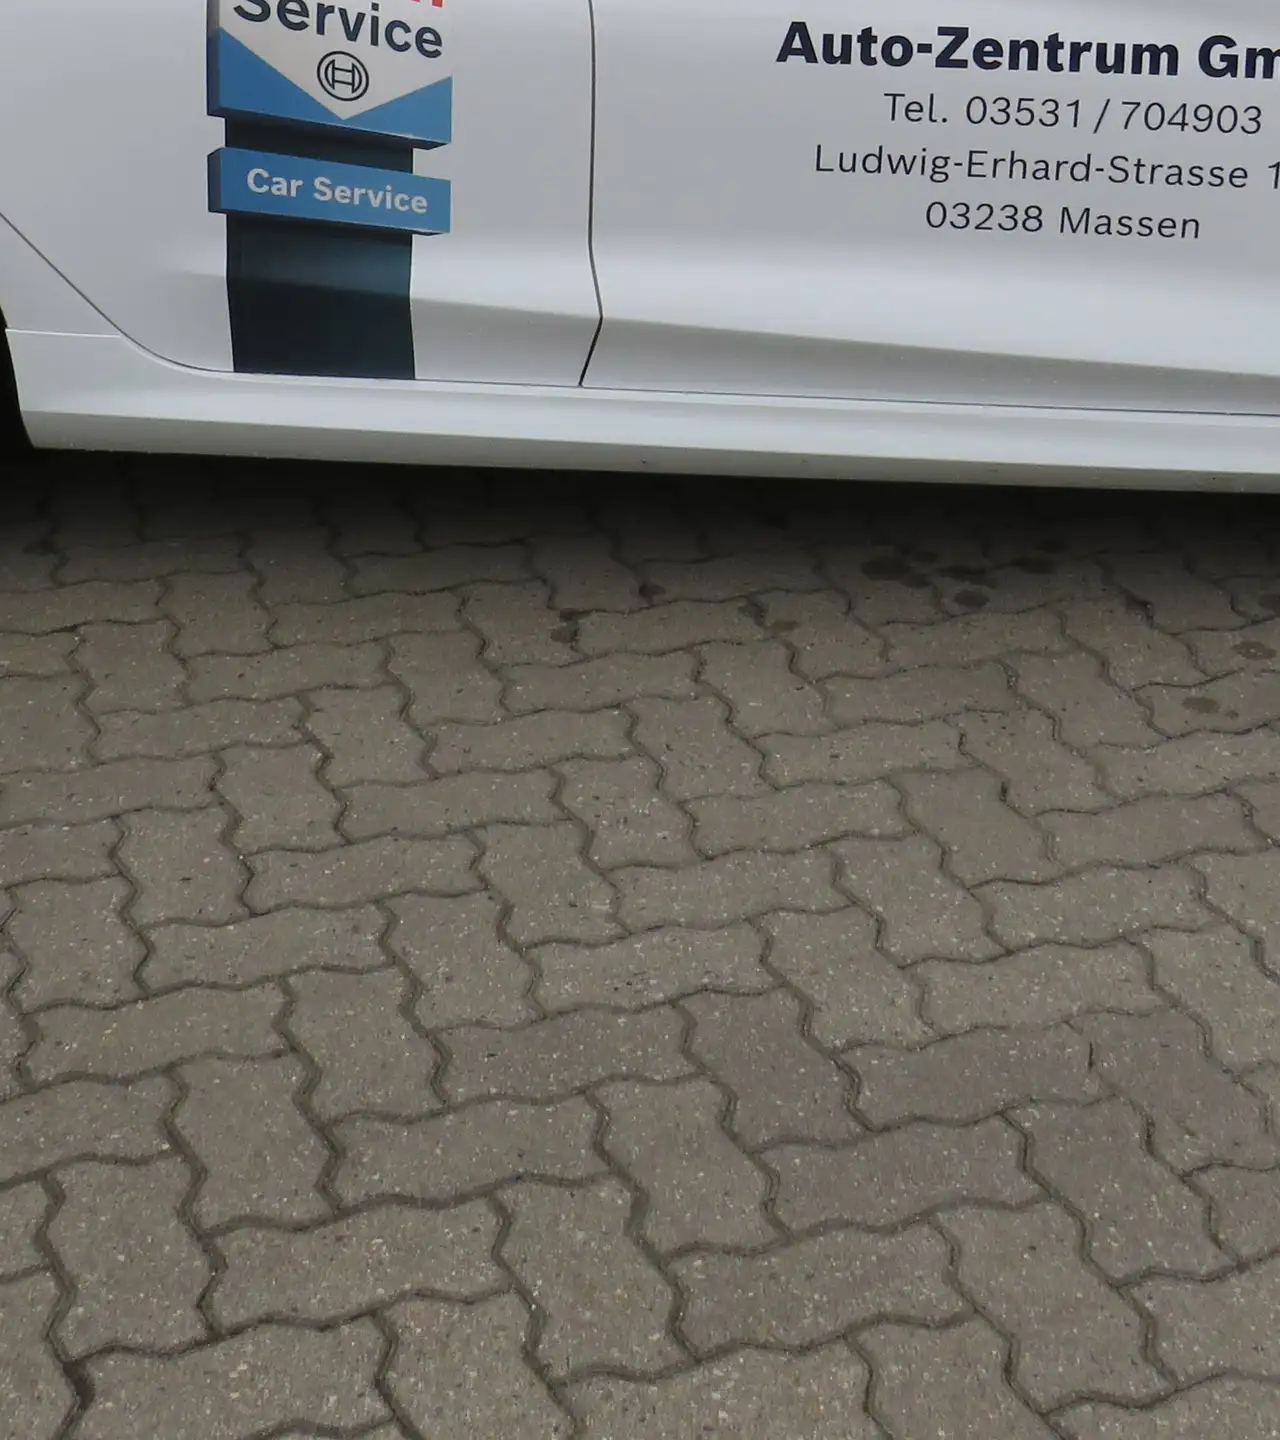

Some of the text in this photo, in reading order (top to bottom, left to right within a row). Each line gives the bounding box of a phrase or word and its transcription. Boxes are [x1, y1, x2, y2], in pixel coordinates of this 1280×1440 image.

[776, 22, 1179, 76] Auto-Zentrum
[883, 92, 1262, 135] Tel. 03531 / 704903
[815, 144, 1248, 189] Ludwig-Erhard-Strasse
[246, 168, 429, 214] Car Service
[925, 201, 1200, 239] 03238 Massen
